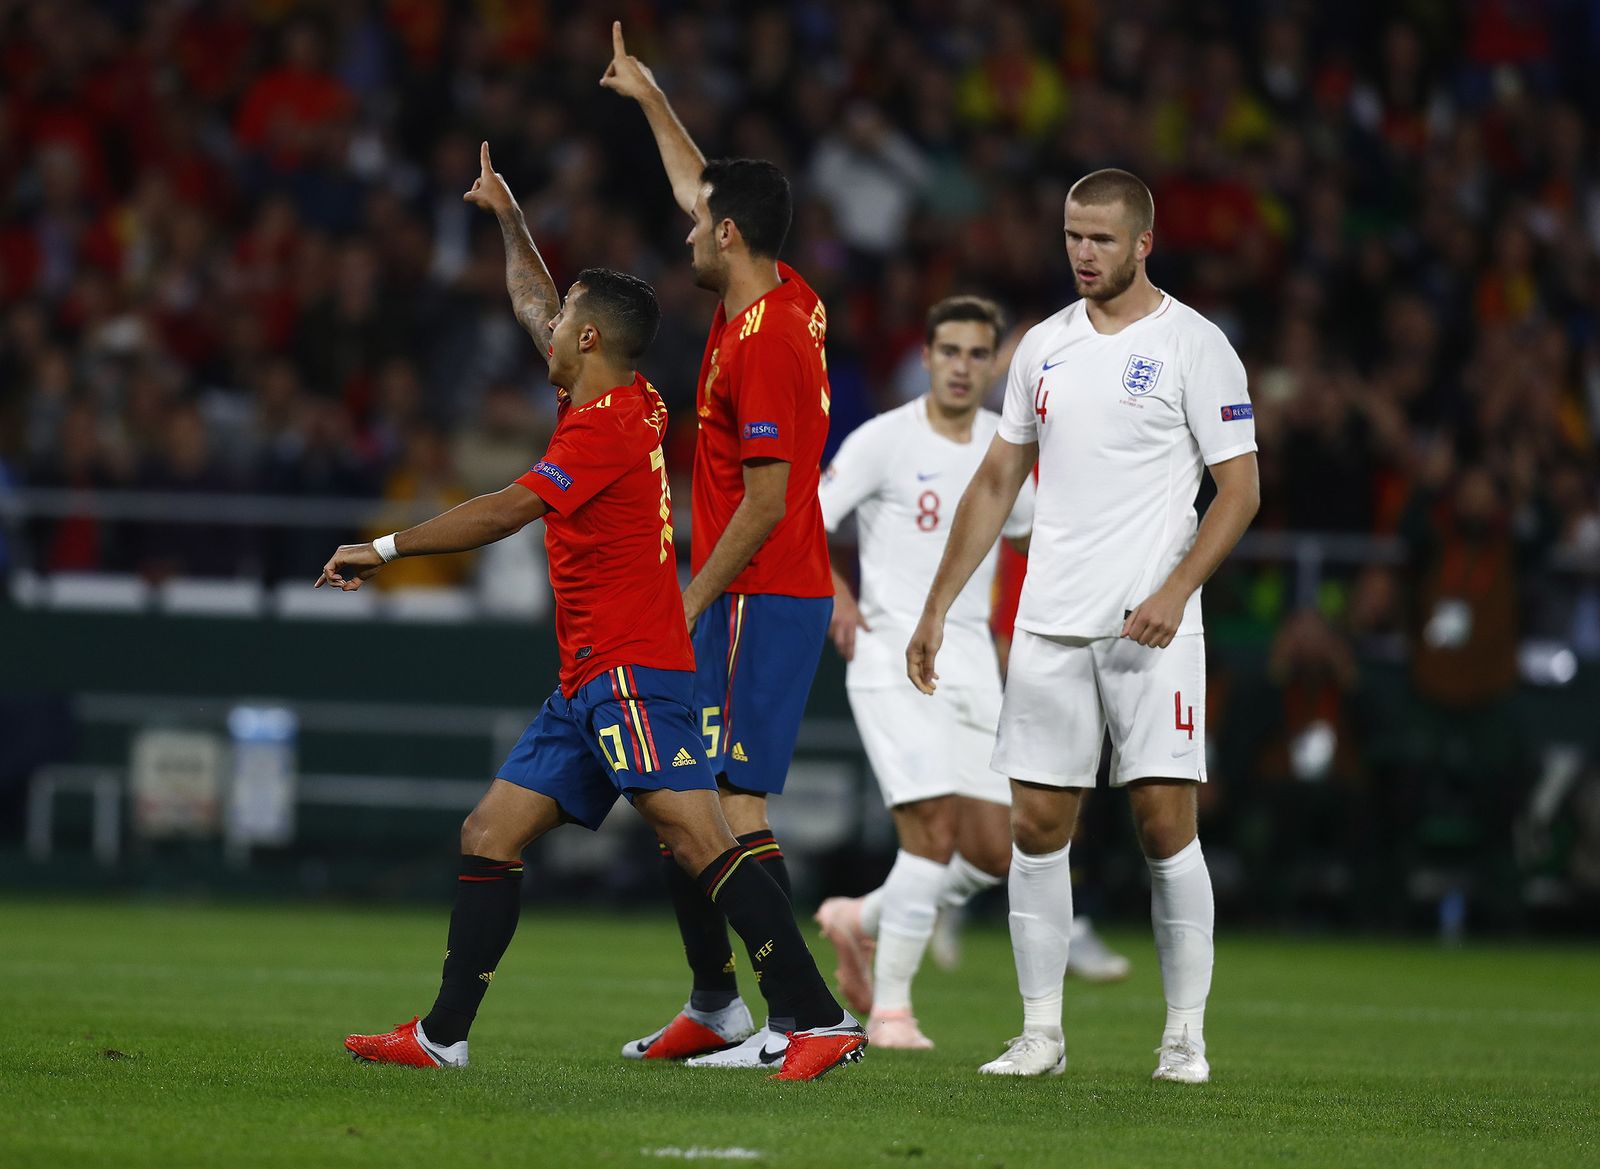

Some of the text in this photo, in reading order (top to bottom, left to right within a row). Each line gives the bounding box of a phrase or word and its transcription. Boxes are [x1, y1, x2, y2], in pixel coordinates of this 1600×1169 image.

[1035, 376, 1049, 425] 4
[542, 465, 571, 488] RESPECT
[916, 489, 940, 533] 8
[702, 706, 720, 758] 5
[1175, 690, 1194, 740] 4
[671, 758, 697, 767] adidas
